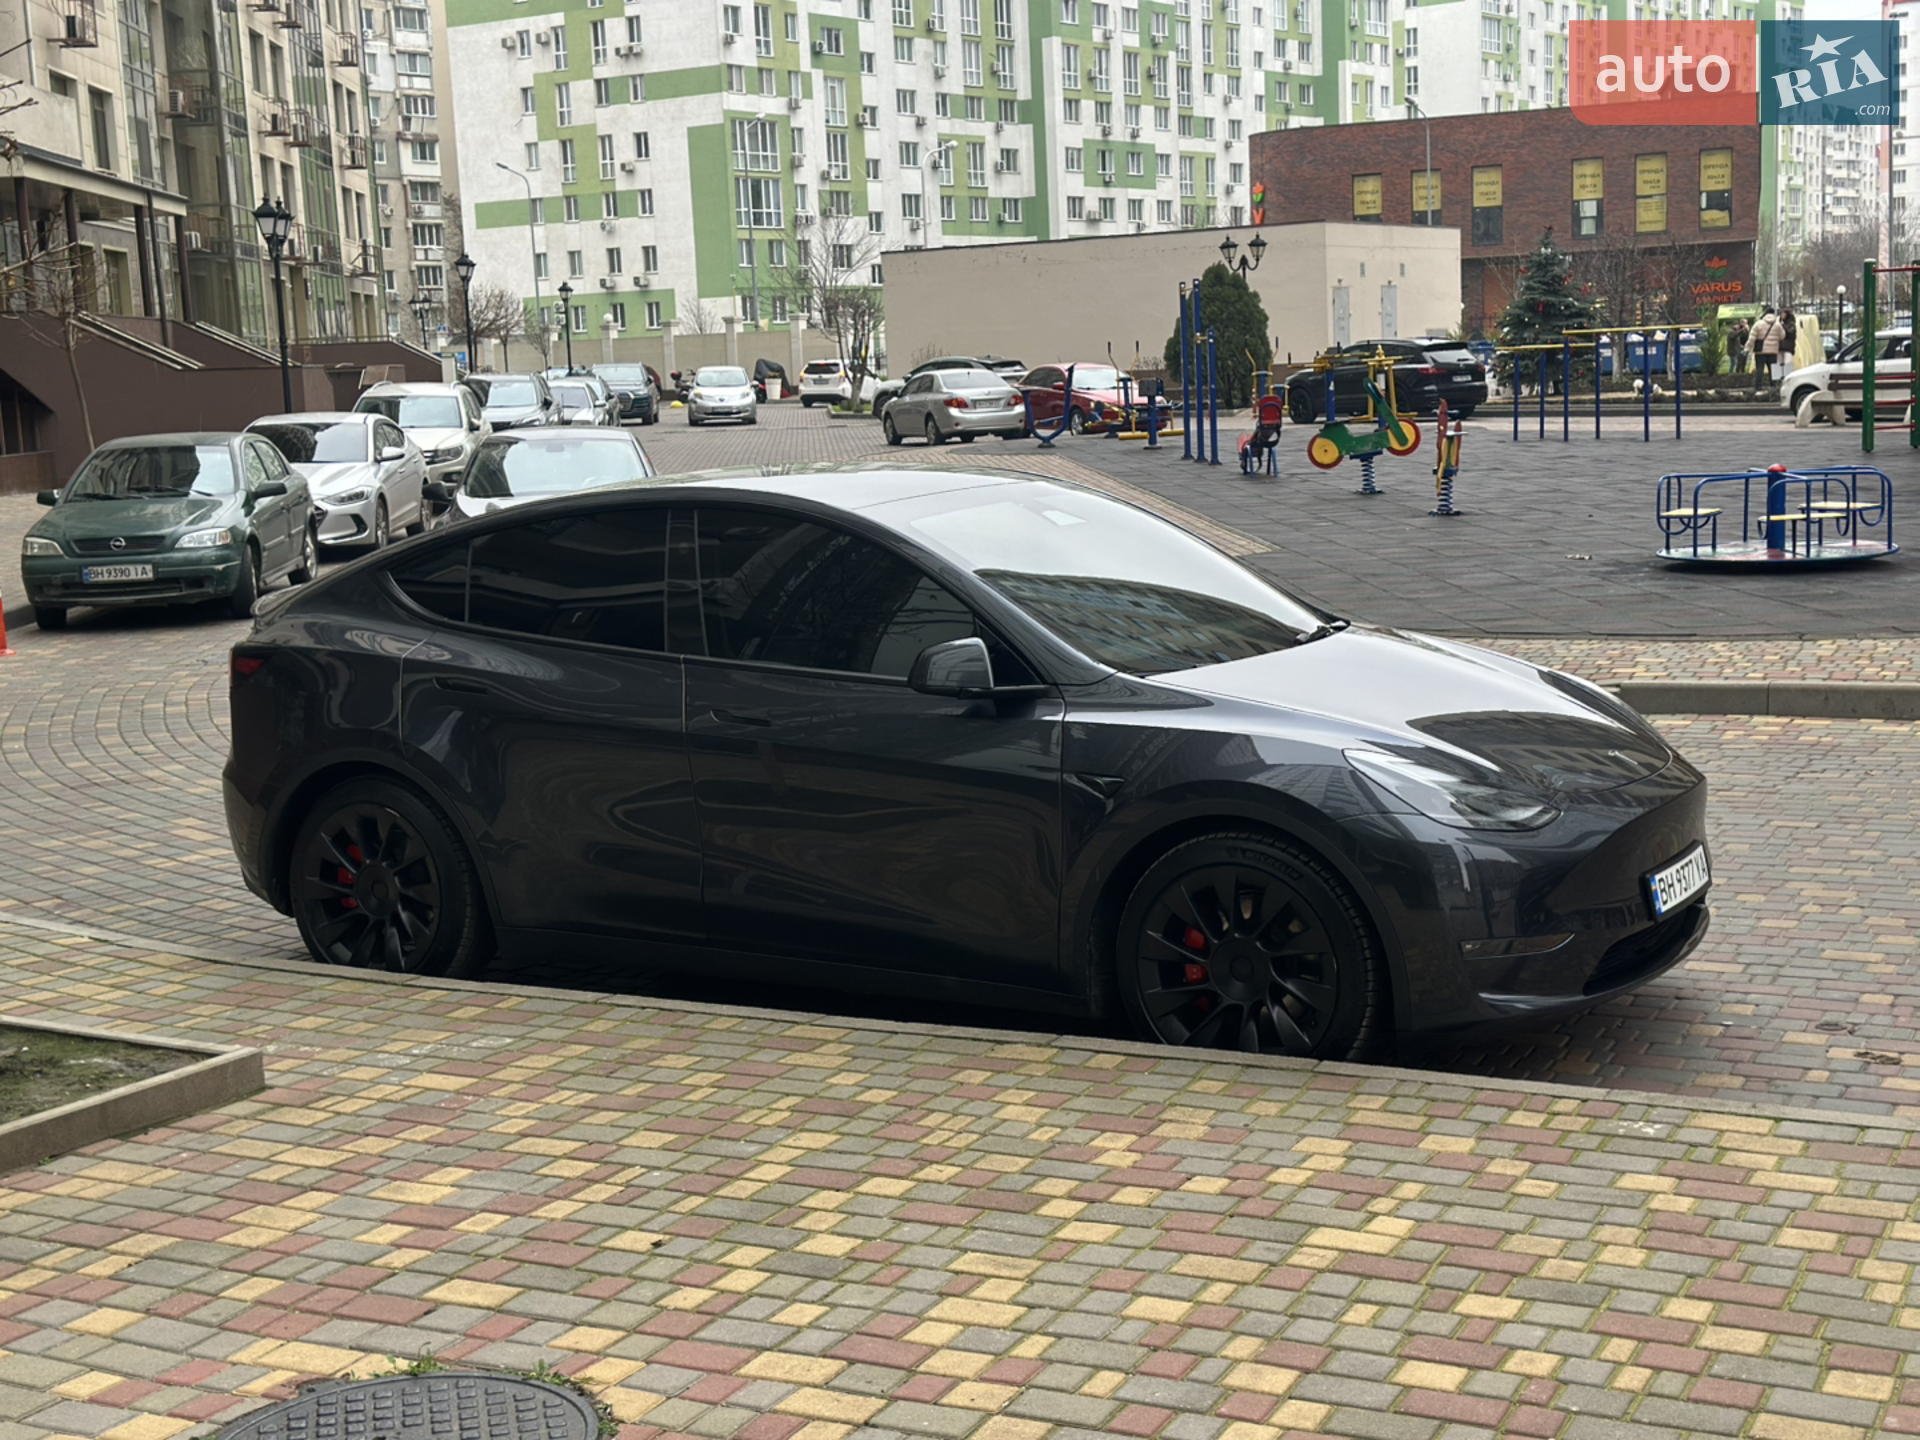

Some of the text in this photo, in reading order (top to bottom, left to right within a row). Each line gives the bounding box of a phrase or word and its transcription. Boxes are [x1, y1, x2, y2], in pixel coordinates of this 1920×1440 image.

[1690, 280, 1743, 295] VARUS
[88, 568, 104, 579] BH
[105, 567, 131, 579] 9390
[1657, 870, 1677, 906] BH
[1675, 859, 1696, 897] 9377
